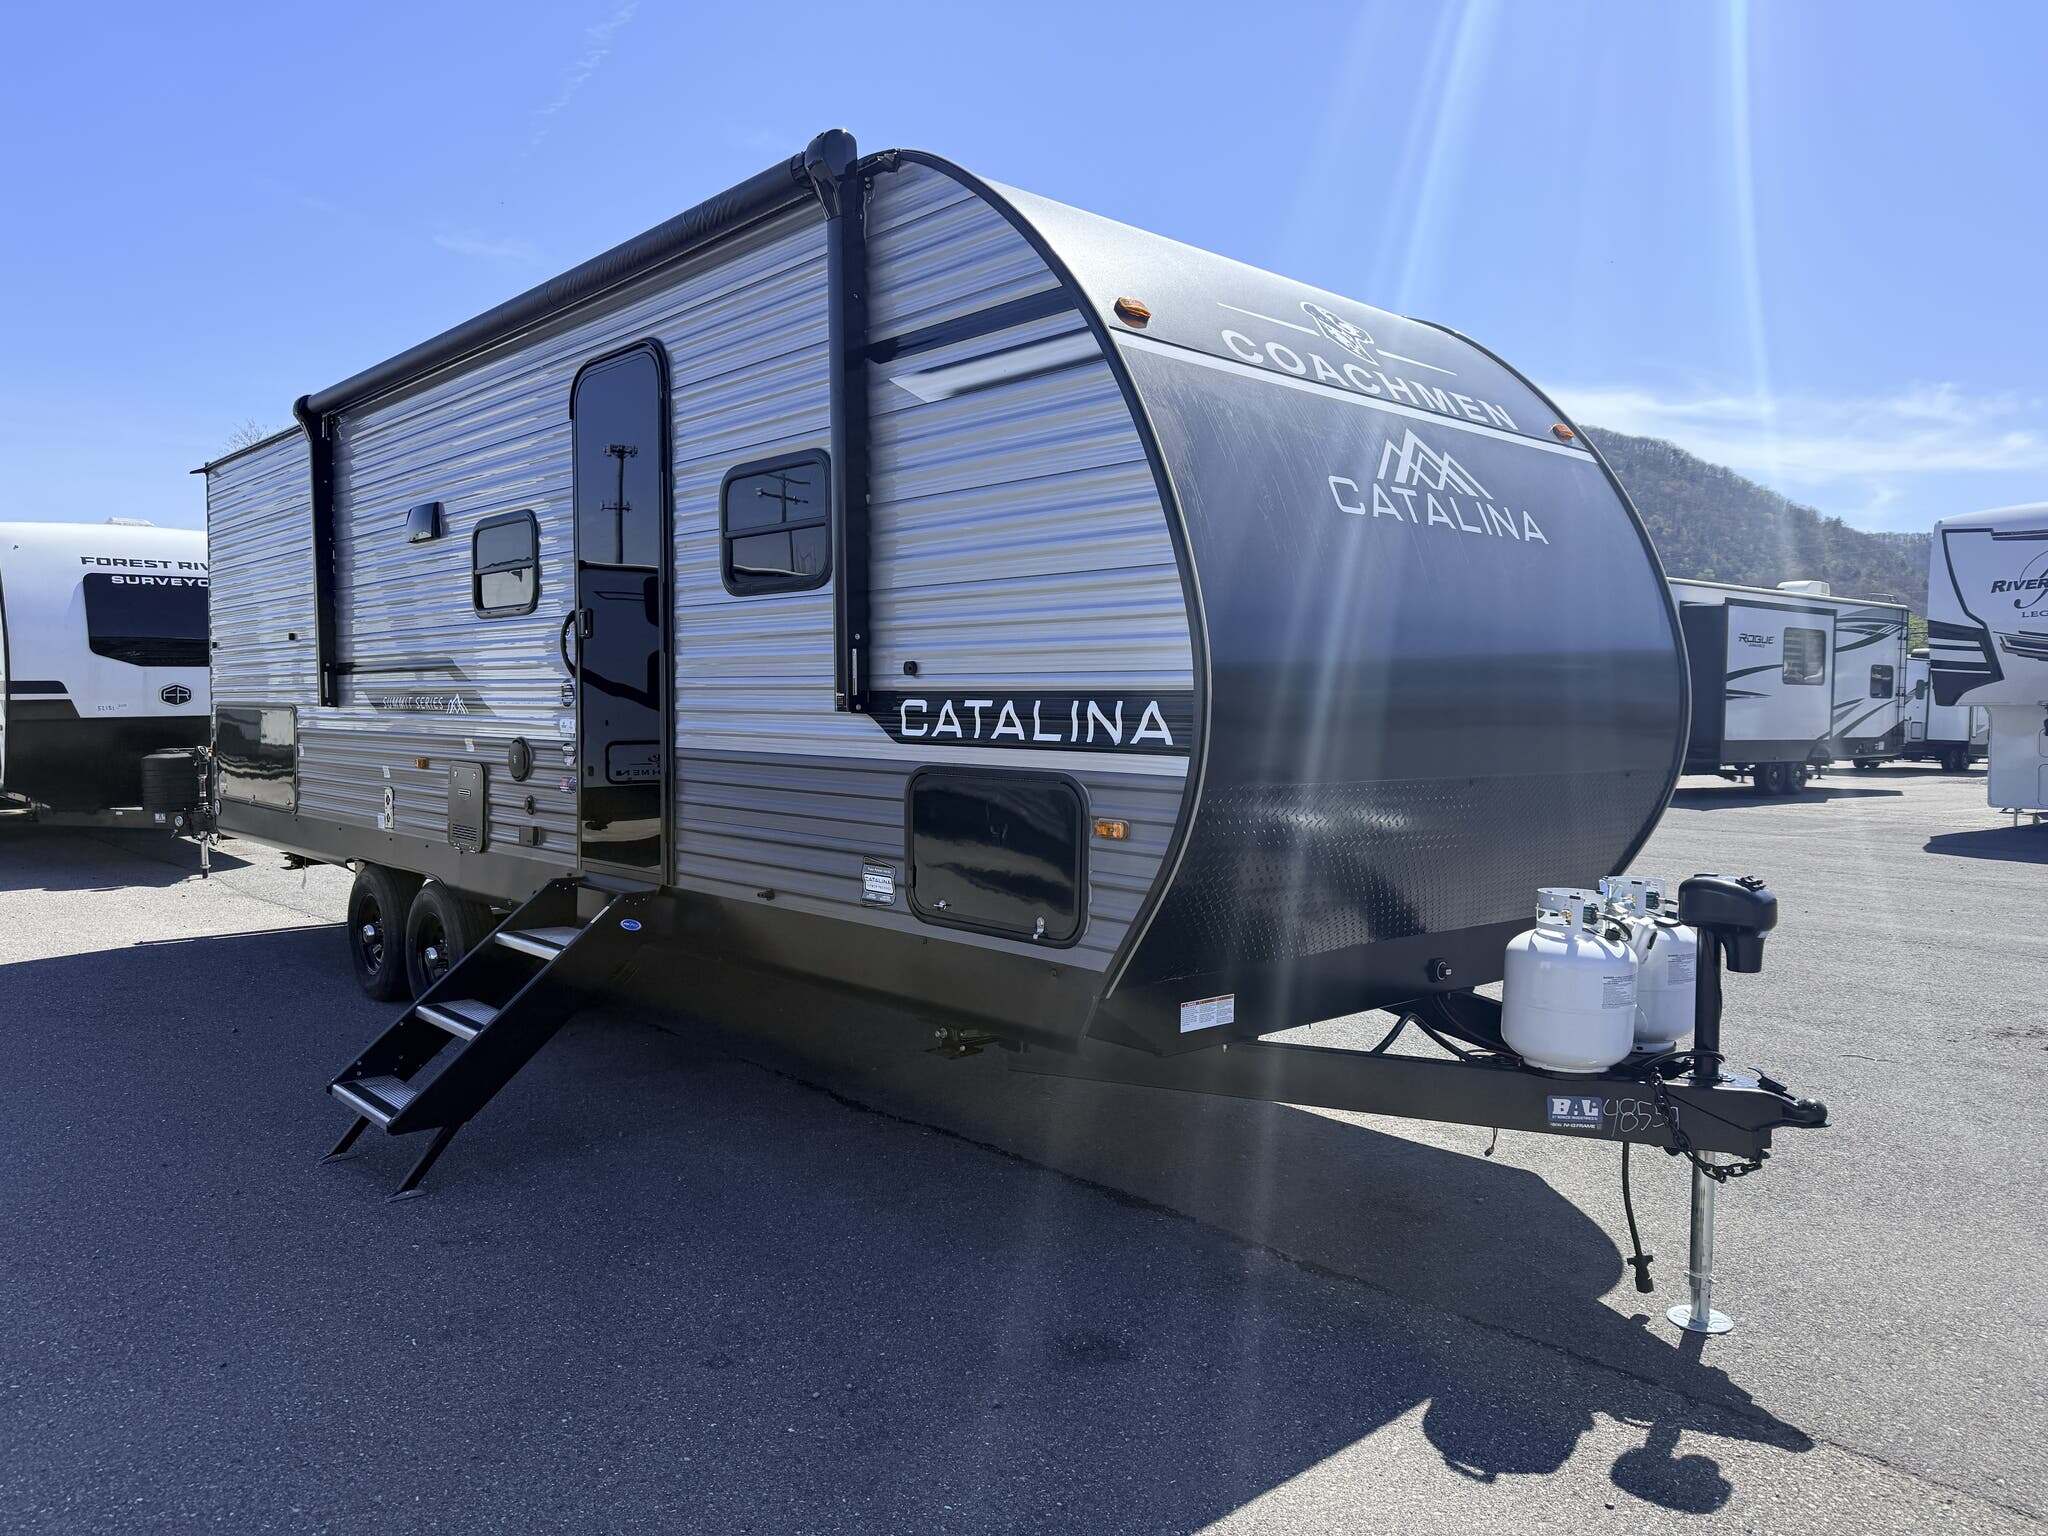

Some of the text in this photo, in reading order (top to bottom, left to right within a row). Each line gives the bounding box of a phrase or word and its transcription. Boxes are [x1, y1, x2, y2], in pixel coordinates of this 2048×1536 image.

[1220, 329, 1520, 431] COACHMEN
[1327, 474, 1550, 545] CATALINA
[80, 556, 172, 569] FOREST
[1738, 633, 1775, 645] ROGUE
[382, 696, 445, 711] SUMMIT SERIES
[900, 699, 1174, 746] CATALINA
